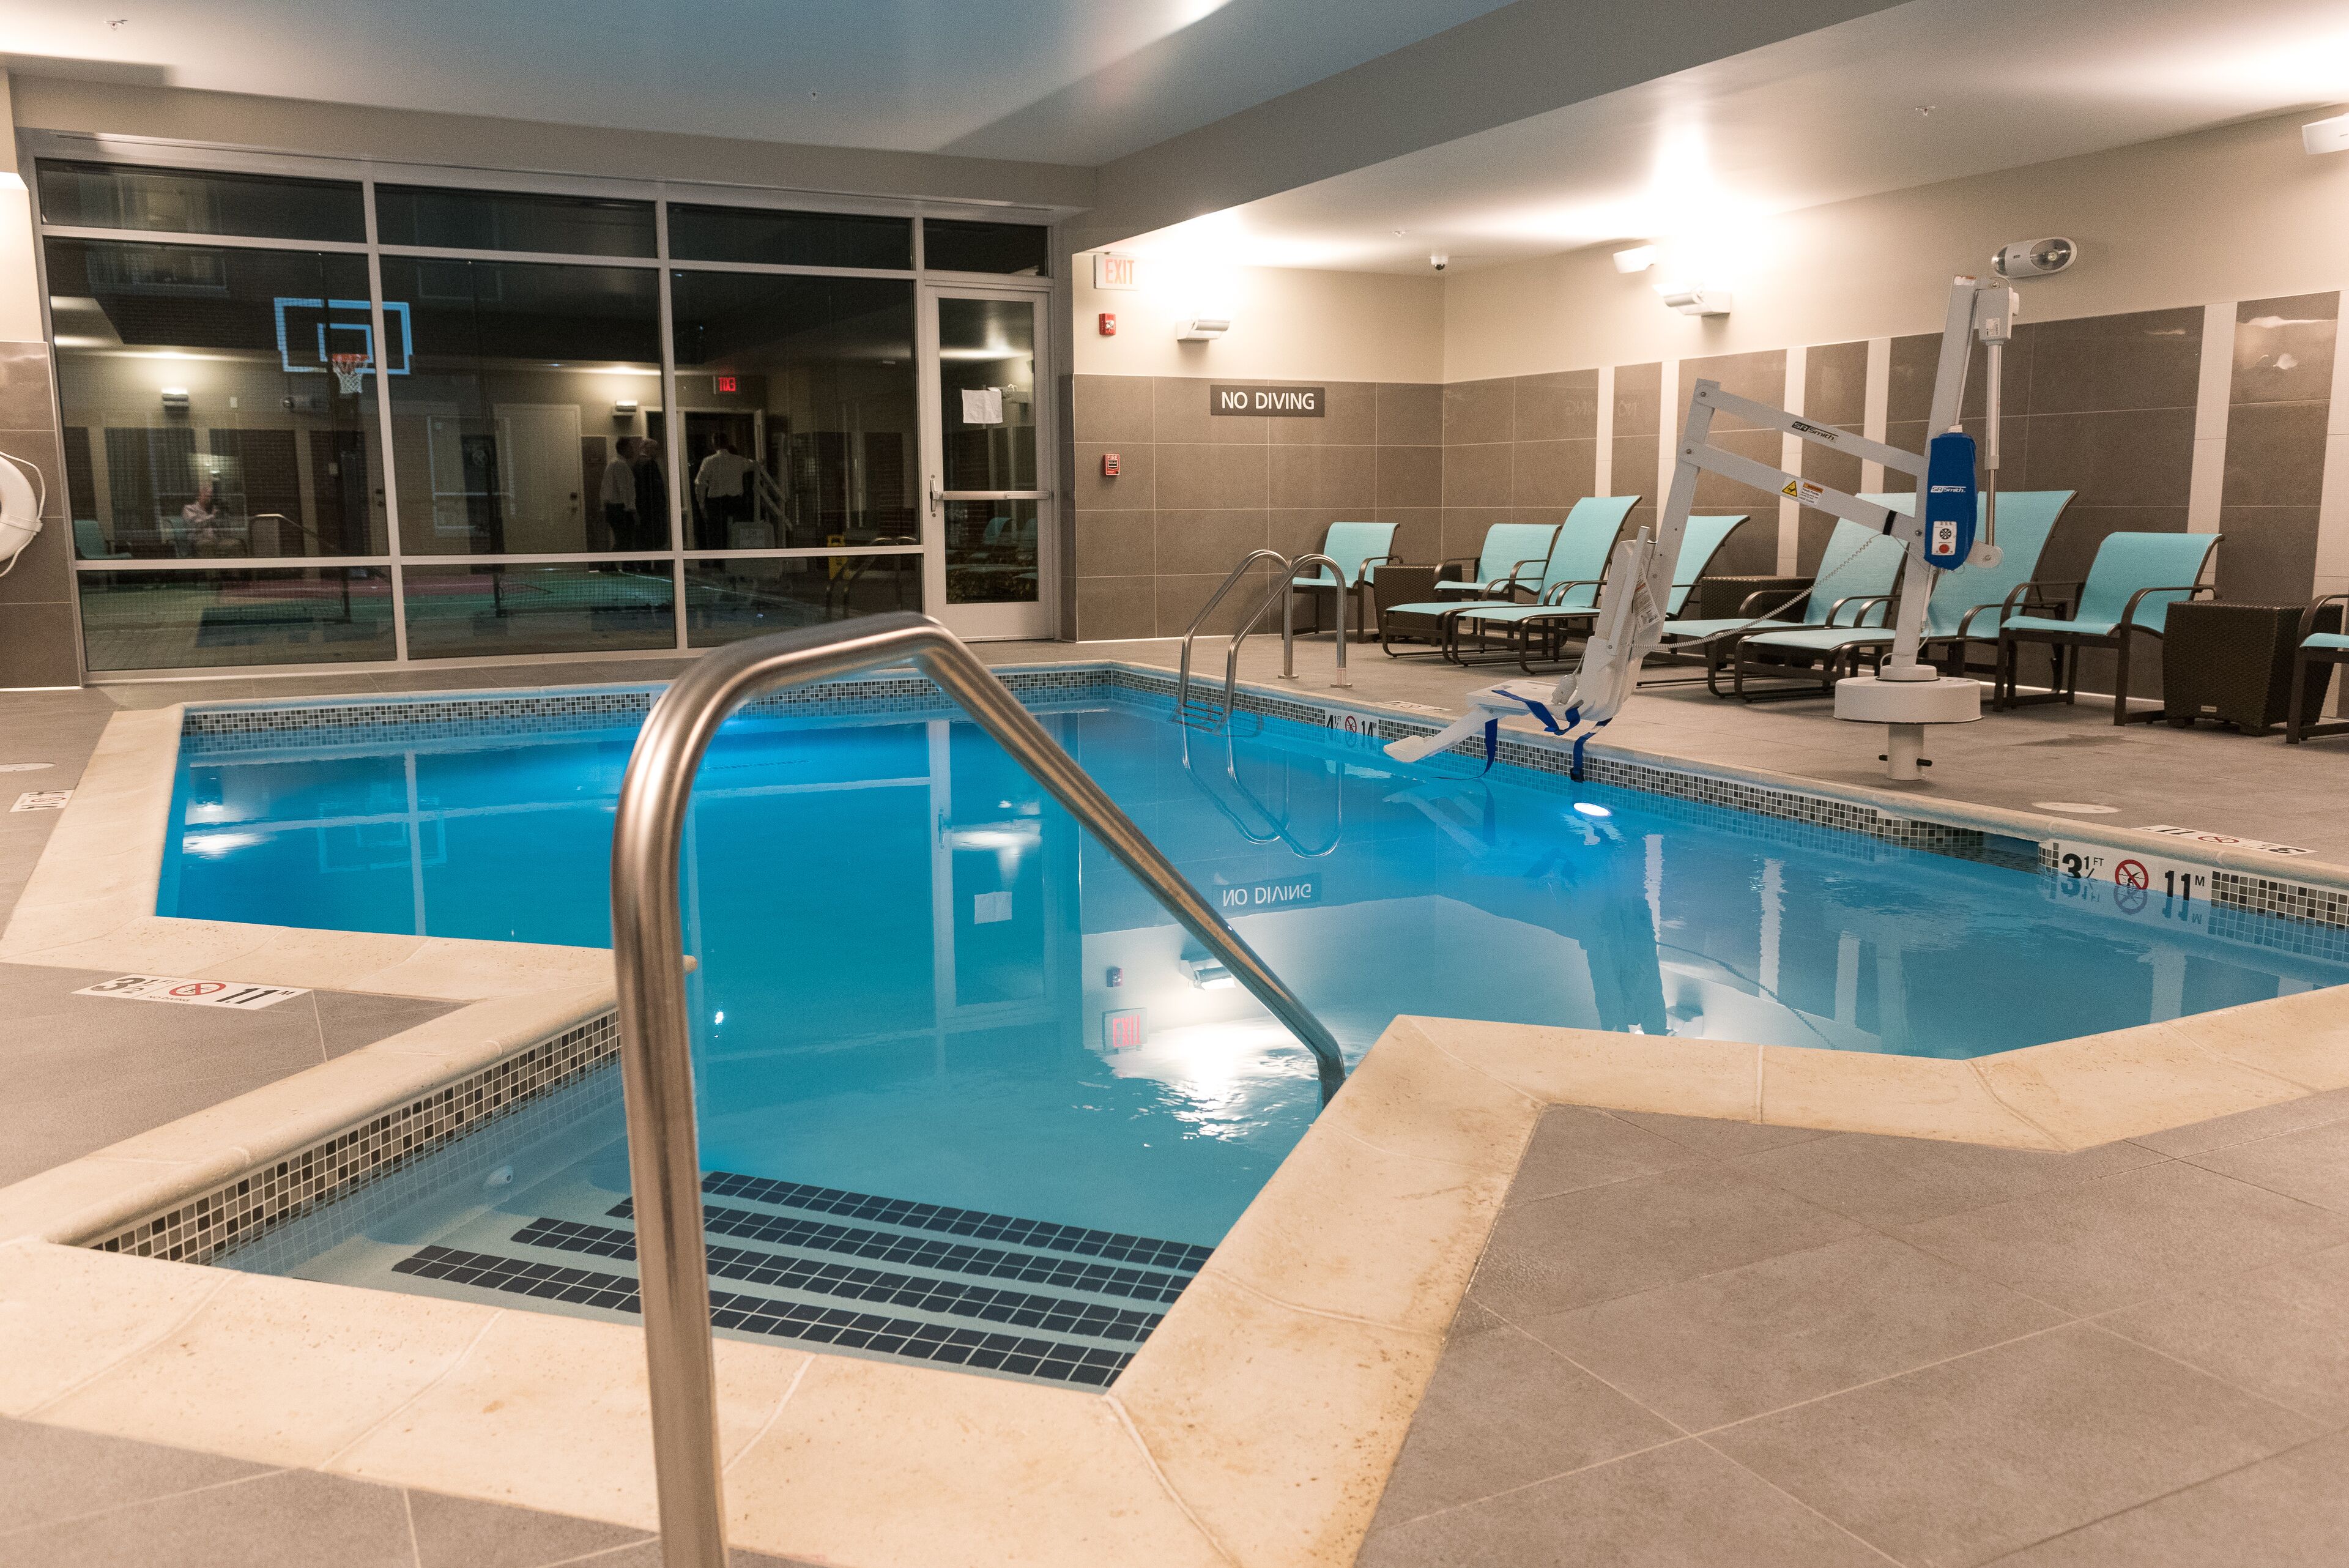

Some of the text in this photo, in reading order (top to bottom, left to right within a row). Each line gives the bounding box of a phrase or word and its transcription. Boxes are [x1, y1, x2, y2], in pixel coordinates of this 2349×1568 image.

[1105, 259, 1135, 284] EXIT
[1222, 392, 1315, 410] NO DIVING
[2093, 856, 2104, 867] FT
[2194, 875, 2205, 886] M
